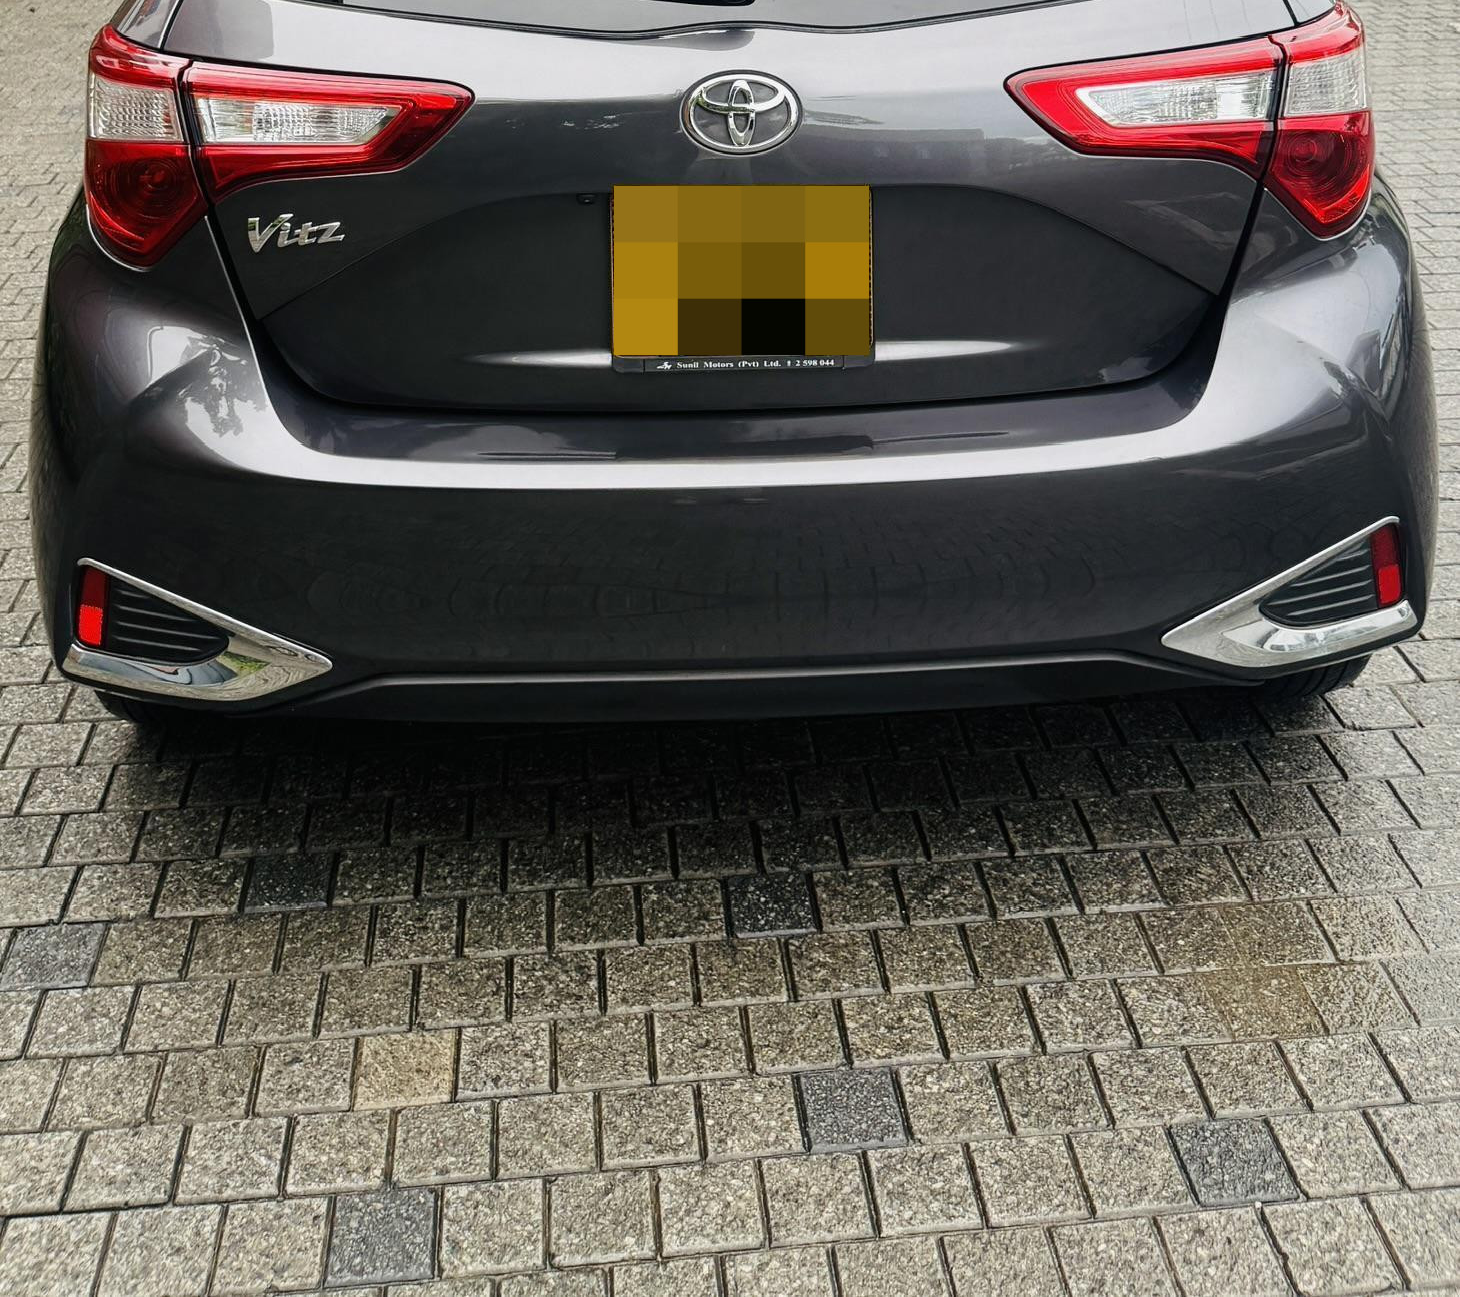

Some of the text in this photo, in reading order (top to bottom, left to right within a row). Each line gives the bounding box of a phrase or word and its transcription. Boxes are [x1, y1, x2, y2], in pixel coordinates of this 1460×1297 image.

[247, 213, 345, 253] Vitz
[676, 361, 699, 369] Sunil
[738, 360, 759, 368] (Pvt)
